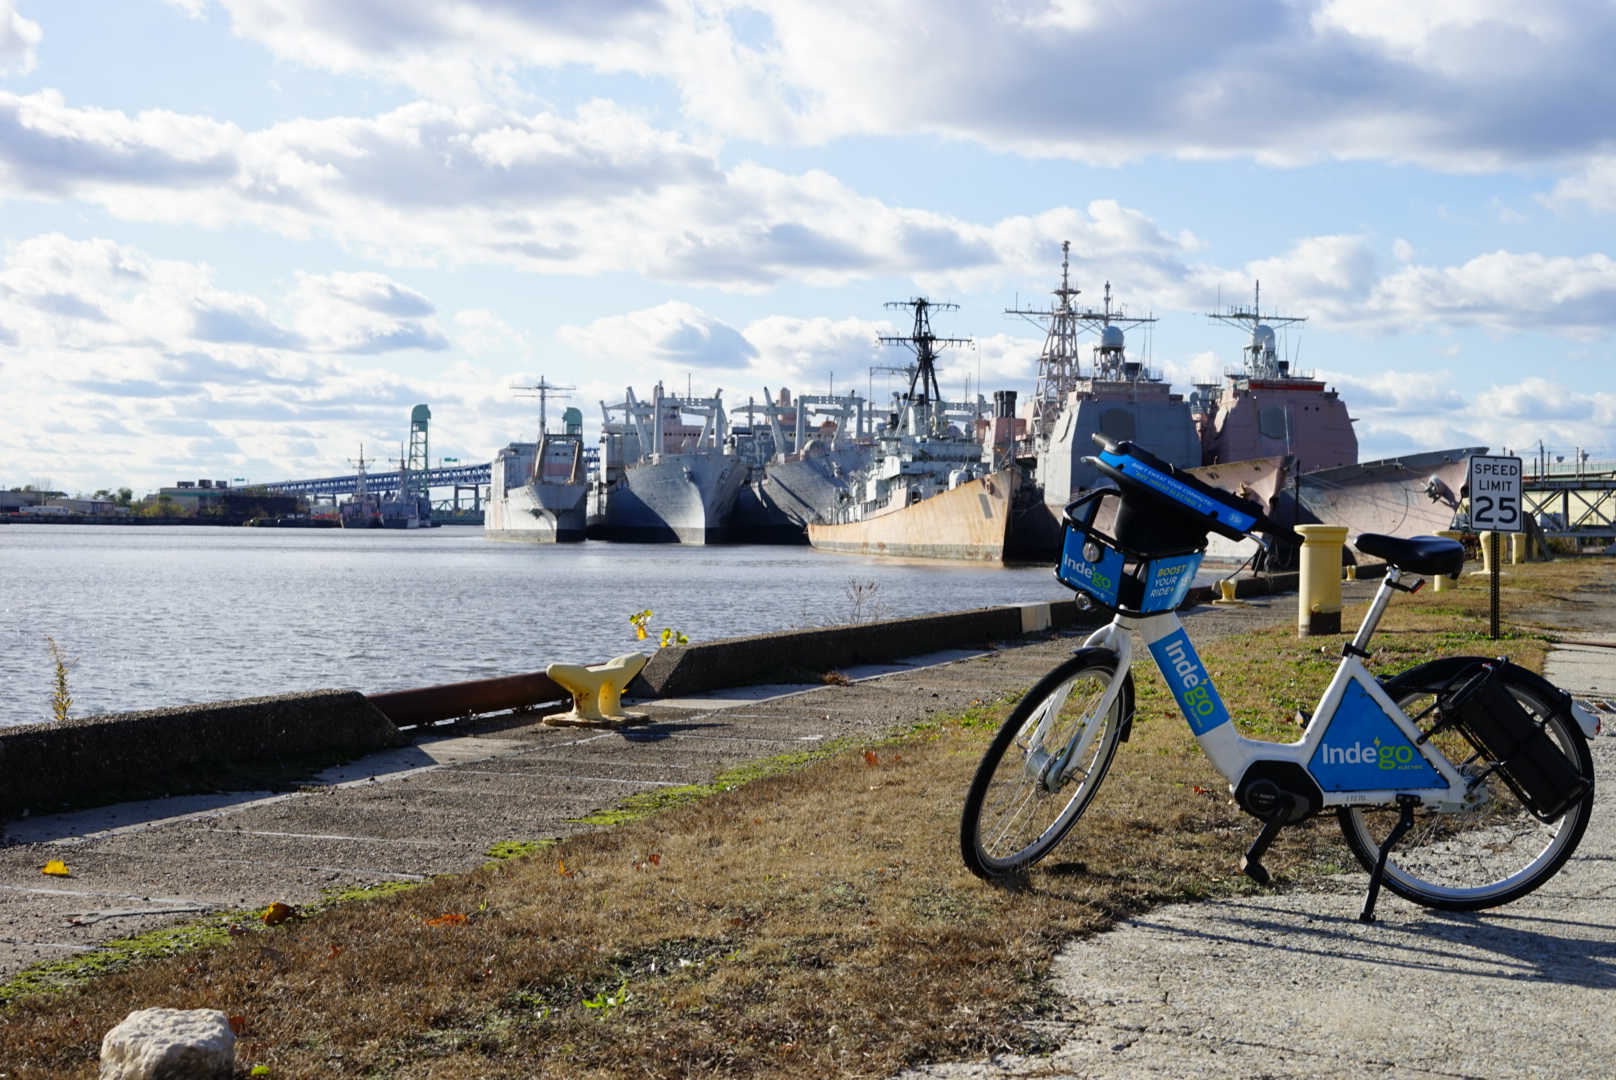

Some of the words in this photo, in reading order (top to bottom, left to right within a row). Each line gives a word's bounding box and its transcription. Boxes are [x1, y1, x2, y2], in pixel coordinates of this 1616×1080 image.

[1474, 463, 1518, 476] SPEED
[1131, 462, 1148, 473] DON'T
[1148, 469, 1166, 482] SWEAT
[1167, 479, 1183, 491] YOUR
[1182, 488, 1214, 508] COMMUTE!
[1149, 478, 1170, 491] INDEGO
[1169, 489, 1197, 506] ELECTRIC
[1479, 479, 1513, 492] LIMIT
[1474, 495, 1518, 524] 25
[1064, 553, 1111, 589] Indego
[1155, 576, 1178, 587] YOUR
[1157, 564, 1187, 577] BOOST
[1150, 586, 1170, 598] RIDE
[1164, 639, 1214, 716] Indego
[1322, 741, 1413, 770] Indego
